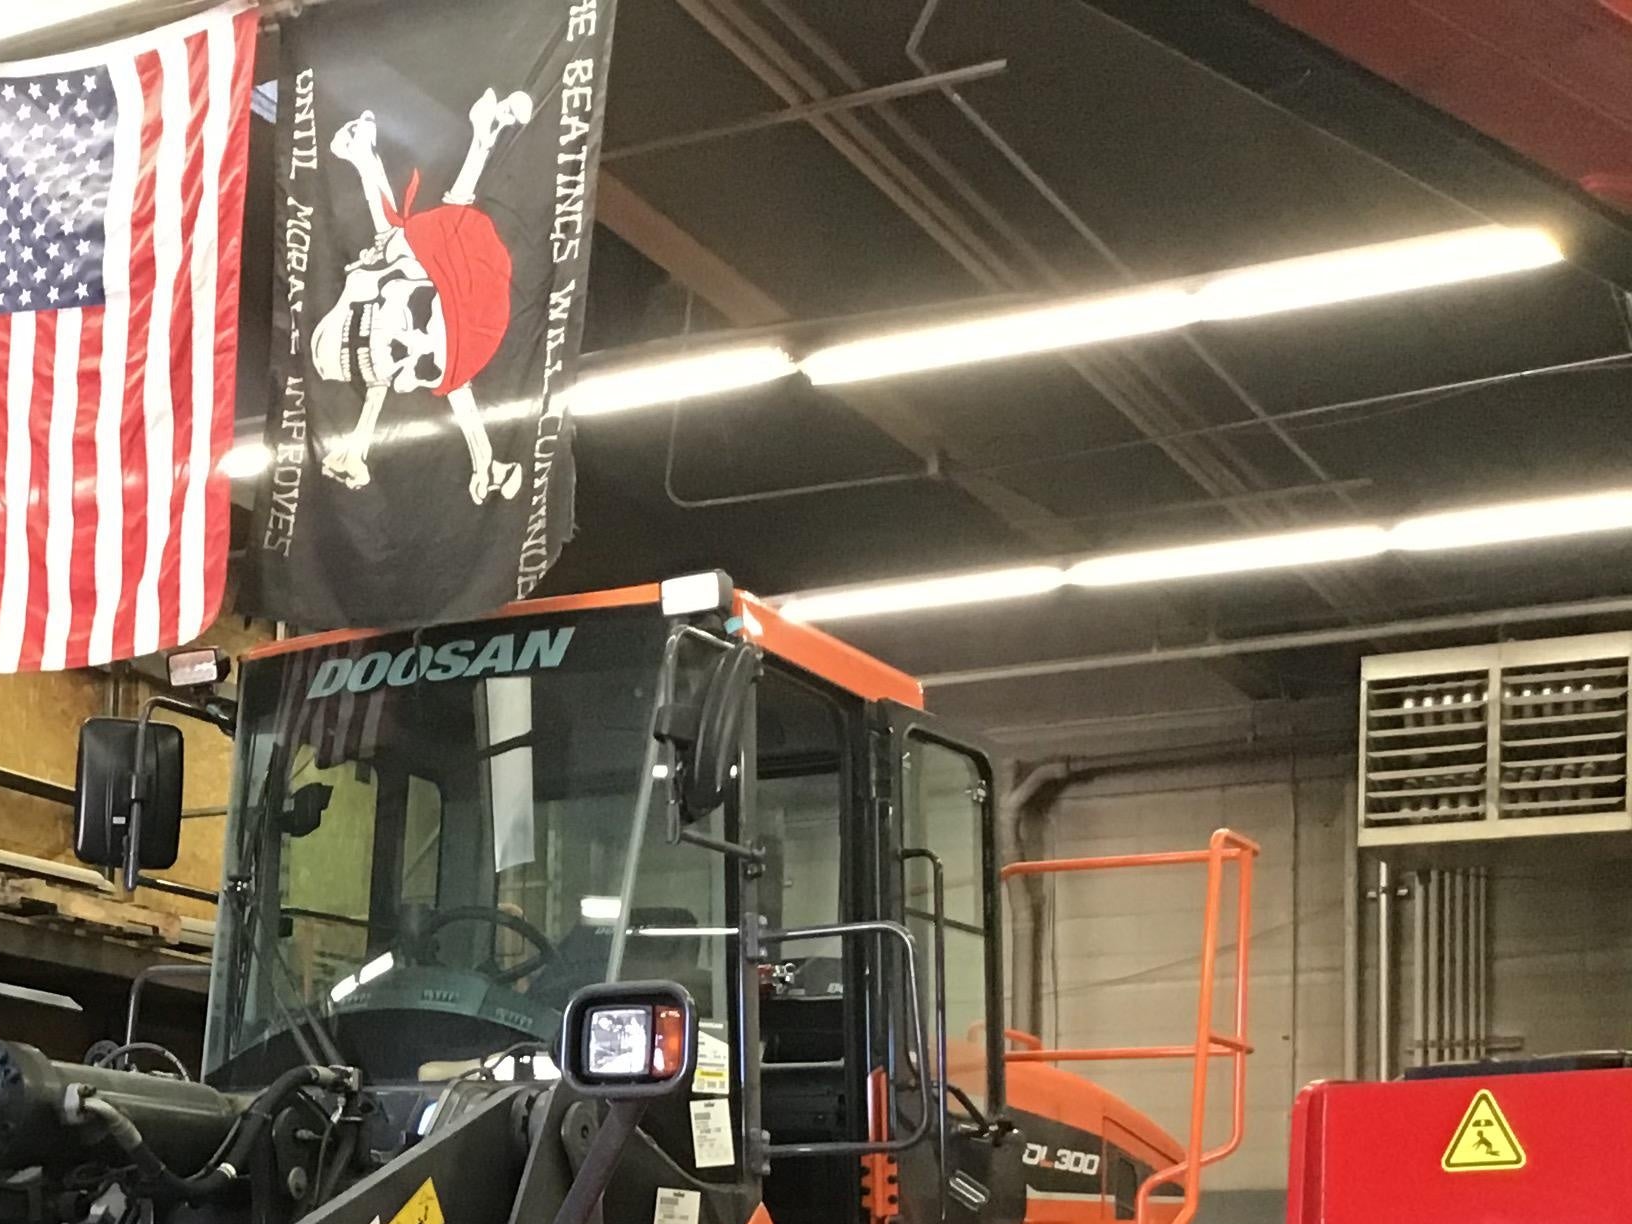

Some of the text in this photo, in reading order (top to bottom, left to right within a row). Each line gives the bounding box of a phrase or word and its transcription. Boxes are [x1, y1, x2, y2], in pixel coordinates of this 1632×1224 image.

[567, 0, 596, 41] HE
[289, 67, 318, 180] UNTIL
[550, 58, 594, 264] BEATINGS
[263, 375, 306, 557] IMPROVES
[306, 626, 576, 699] DOOSAN
[1021, 1142, 1101, 1176] DL300
